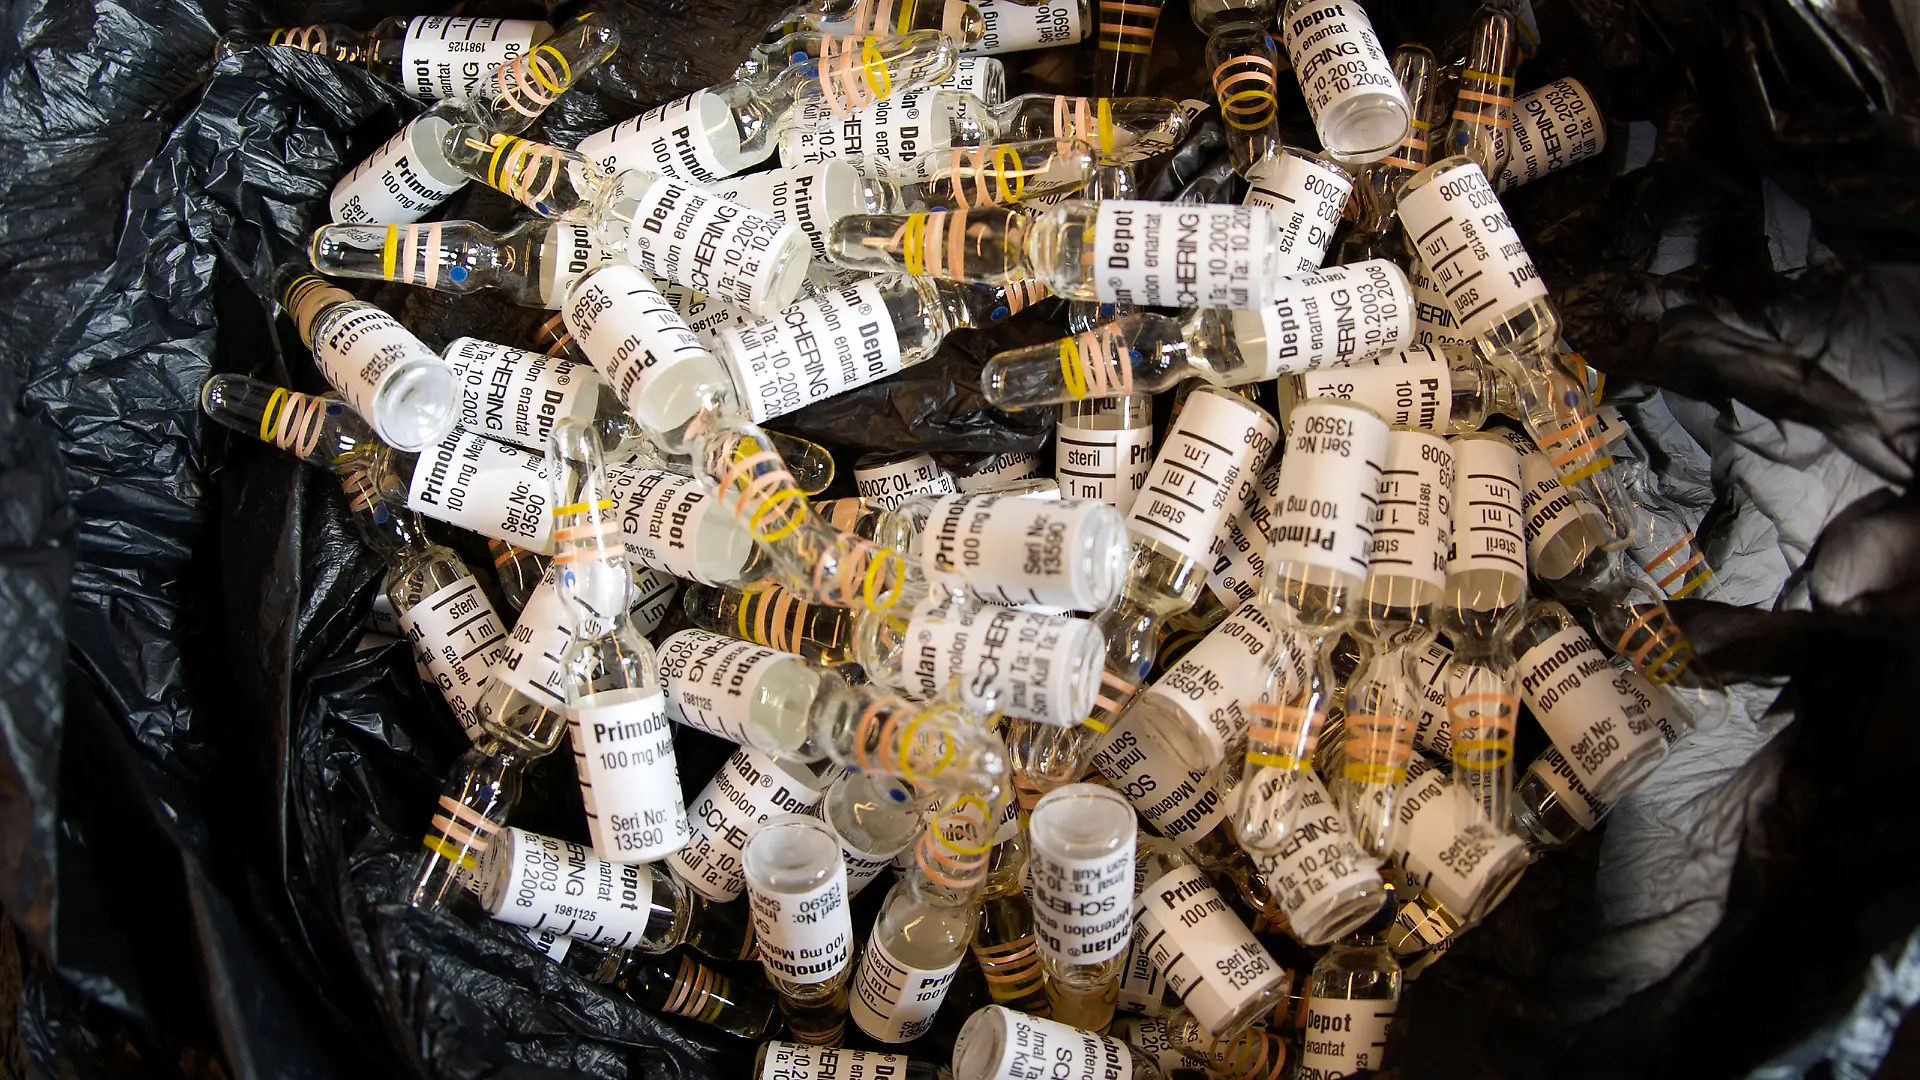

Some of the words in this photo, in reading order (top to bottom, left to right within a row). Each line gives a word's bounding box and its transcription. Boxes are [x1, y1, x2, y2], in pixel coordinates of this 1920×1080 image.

[983, 11, 999, 31] mg
[1038, 23, 1052, 44] Seri
[1052, 8, 1070, 42] 13590
[1293, 4, 1345, 37] Depot
[985, 32, 999, 50] 100
[1302, 22, 1348, 50] enantat
[1313, 60, 1367, 94] 10.2003
[651, 137, 670, 164] 100
[382, 169, 400, 194] 100
[396, 193, 416, 209] mg
[773, 181, 787, 209] 100
[350, 195, 368, 221] Seri
[643, 185, 687, 234] Depot
[674, 195, 708, 240] enantat
[723, 215, 765, 269] 10.2003
[1108, 210, 1134, 269] Depot
[1144, 214, 1162, 268] enantat
[1280, 212, 1304, 254] 1981125
[1460, 219, 1490, 261] 1981125
[569, 225, 589, 273] Depot
[1454, 262, 1464, 277] 1
[571, 284, 605, 327] 13590
[1365, 265, 1398, 323] 10.2008
[590, 296, 613, 324] Seri
[1302, 296, 1323, 351] enantat
[1357, 284, 1381, 346] 10.2003
[340, 333, 359, 357] 100
[361, 323, 383, 336] mg
[739, 326, 762, 351] Kull
[1275, 297, 1300, 359] Depot
[475, 349, 496, 366] Ta:
[617, 334, 642, 361] 100
[834, 335, 859, 385] enantat
[858, 321, 888, 379] Depot
[360, 354, 381, 380] Seri
[366, 351, 405, 387] 13590
[750, 352, 768, 377] Ta:
[761, 326, 779, 346] Ta:
[771, 349, 801, 408] 10.2003
[462, 369, 484, 427] 10.2003
[1396, 381, 1412, 408] 100
[516, 387, 533, 437] enantat
[1305, 416, 1354, 437] 13590
[1068, 449, 1100, 467] steril
[1184, 443, 1210, 469] i.m.
[446, 487, 466, 512] 100
[457, 463, 477, 487] mg
[1070, 479, 1076, 496] 1
[1082, 481, 1103, 499] ml
[1161, 469, 1185, 487] ml
[1187, 480, 1198, 497] 1
[1212, 464, 1240, 511] 1981125
[1485, 483, 1512, 500] i.m.
[509, 480, 532, 506] No:
[501, 506, 521, 534] Seri
[519, 494, 546, 539] 13590
[649, 489, 676, 540] enantat
[668, 491, 705, 549] Depot
[1148, 500, 1186, 524] steril
[1310, 500, 1339, 520] 100
[1482, 508, 1502, 523] ml
[1507, 513, 1514, 529] 1
[963, 537, 980, 568] 100
[1486, 536, 1517, 554] steril
[449, 595, 480, 620] steril
[465, 629, 477, 645] 1
[477, 619, 496, 639] ml
[1220, 621, 1243, 638] 100
[1240, 632, 1265, 655] mg
[442, 645, 471, 686] 1981125
[1163, 673, 1205, 701] 13590
[1538, 688, 1559, 715] 100
[1558, 672, 1582, 697] mg
[1209, 708, 1231, 738] Son
[1108, 731, 1137, 756] Son
[1570, 731, 1594, 762] Seri
[1581, 735, 1620, 776] 13590
[600, 750, 628, 770] 100
[631, 748, 654, 766] mg
[1118, 748, 1147, 776] Imal
[611, 812, 639, 833] Seri
[644, 808, 667, 827] No:
[614, 827, 664, 852] 13590
[695, 834, 716, 860] Ta:
[516, 849, 541, 908] 10.2008
[540, 838, 559, 893] 10.2003
[701, 863, 722, 886] Ta:
[554, 903, 597, 922] 1981125
[1179, 904, 1208, 928] 100
[1216, 952, 1245, 976] Seri
[1228, 957, 1270, 991] 13590
[871, 976, 888, 995] ml
[1016, 1022, 1031, 1048] Son
[1308, 1010, 1352, 1033] Depot
[1033, 1031, 1048, 1061] Imal
